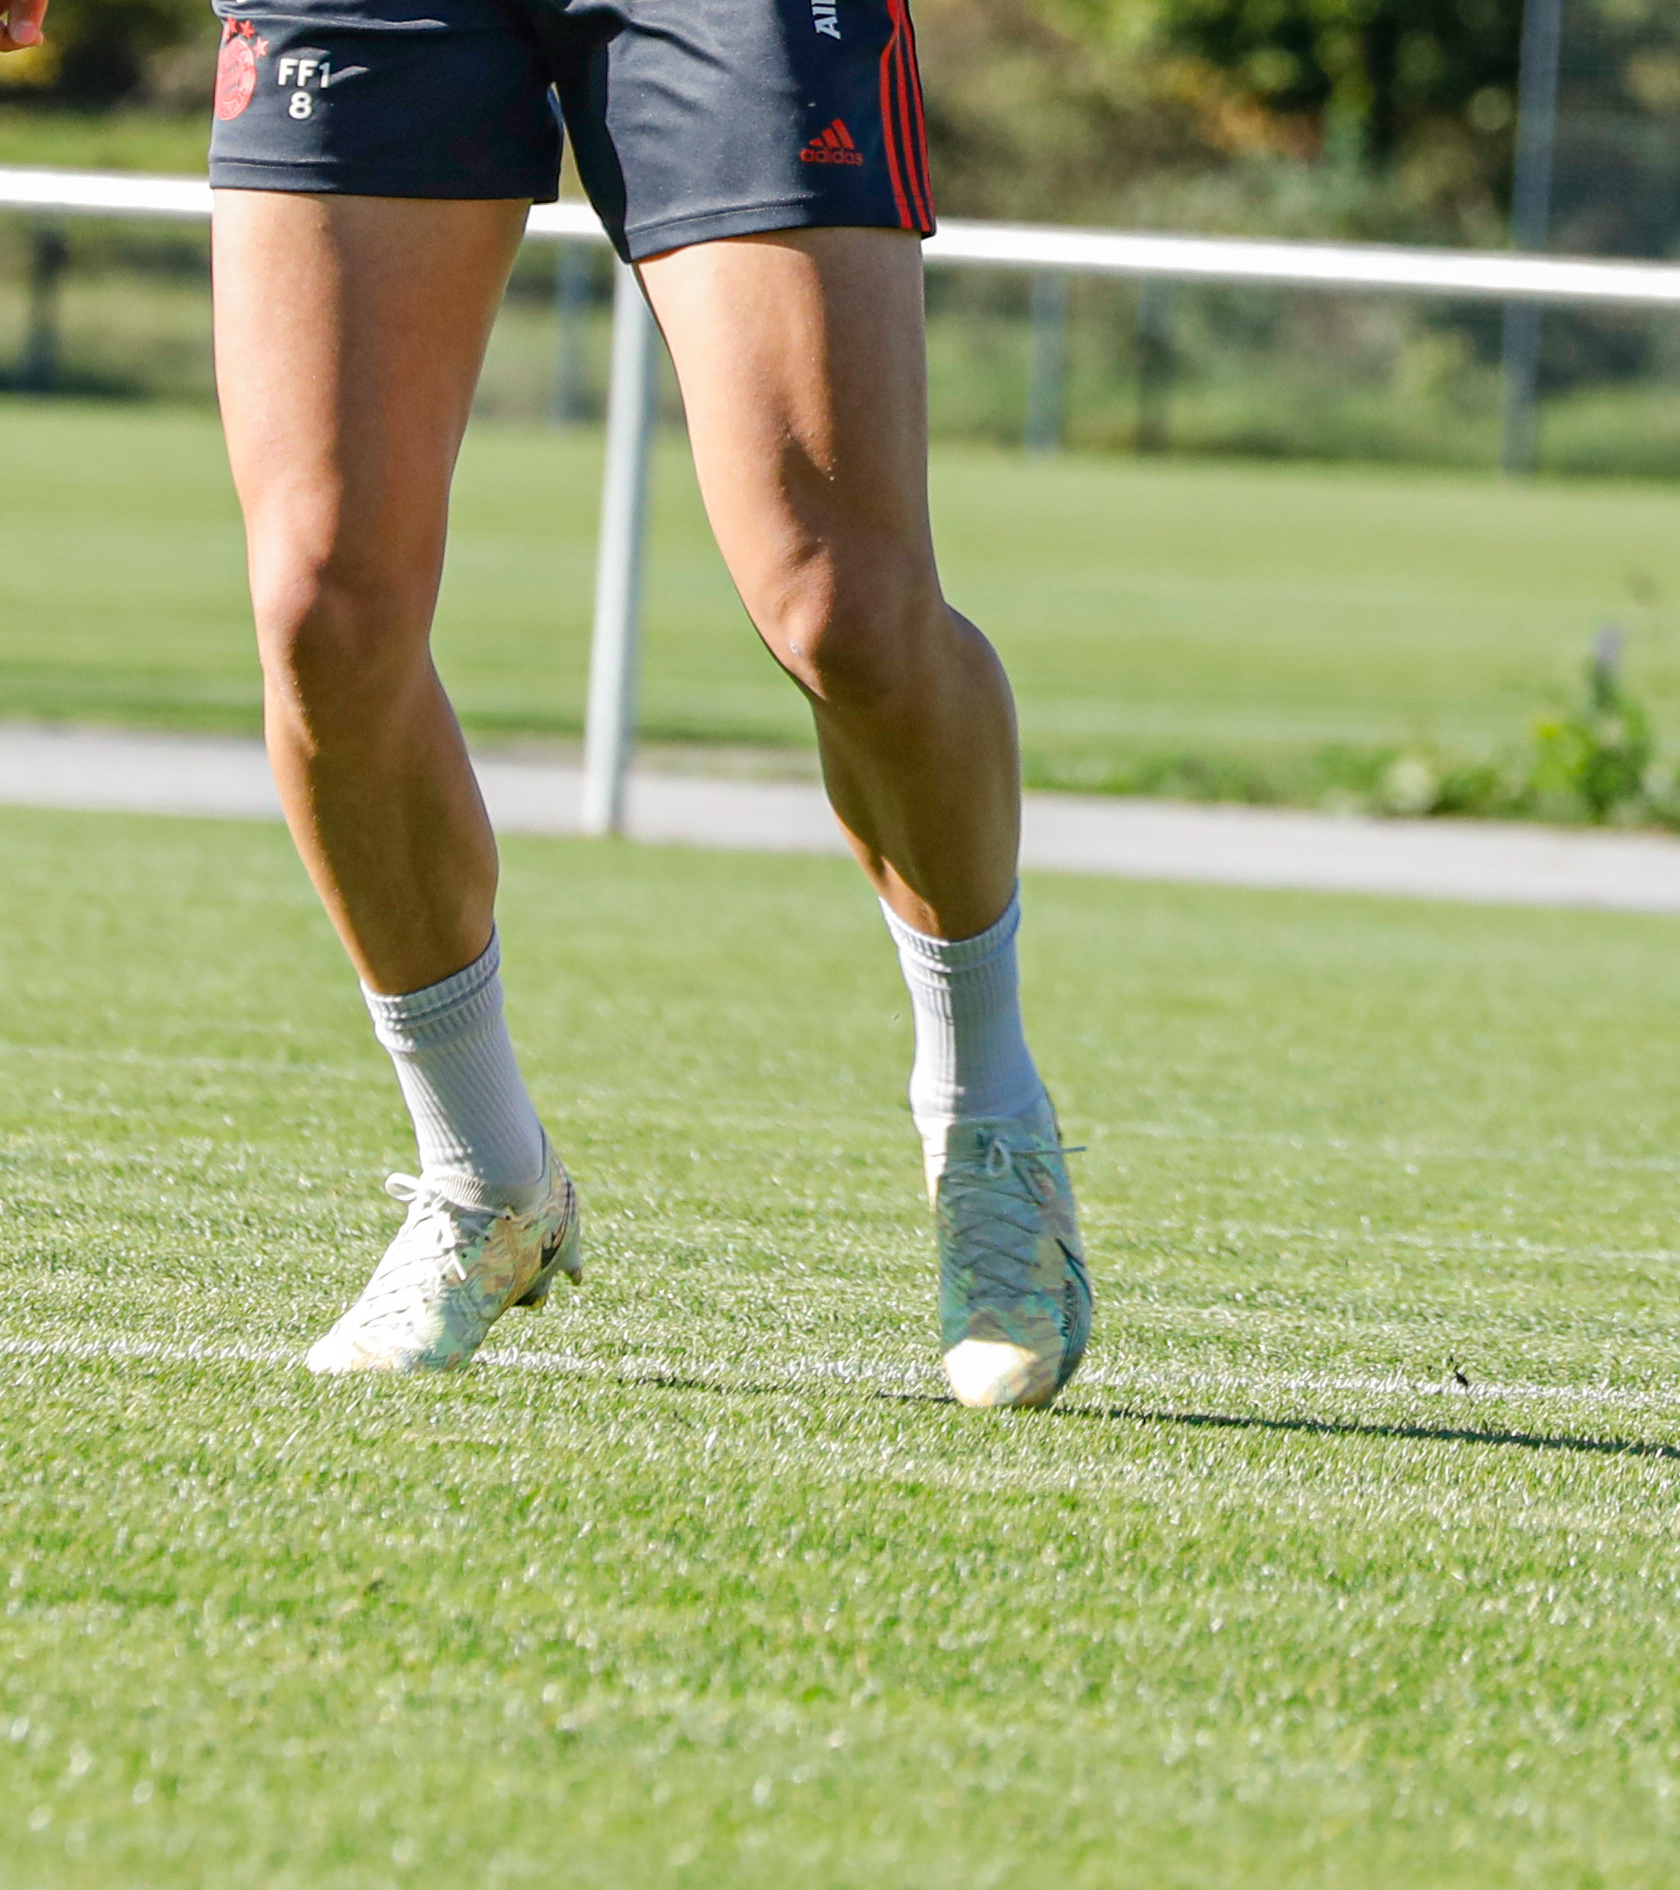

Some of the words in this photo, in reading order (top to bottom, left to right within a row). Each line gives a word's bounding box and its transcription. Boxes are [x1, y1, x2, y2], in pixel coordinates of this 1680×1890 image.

[277, 58, 331, 89] FF1
[288, 90, 313, 120] 8
[799, 147, 864, 166] adidas
